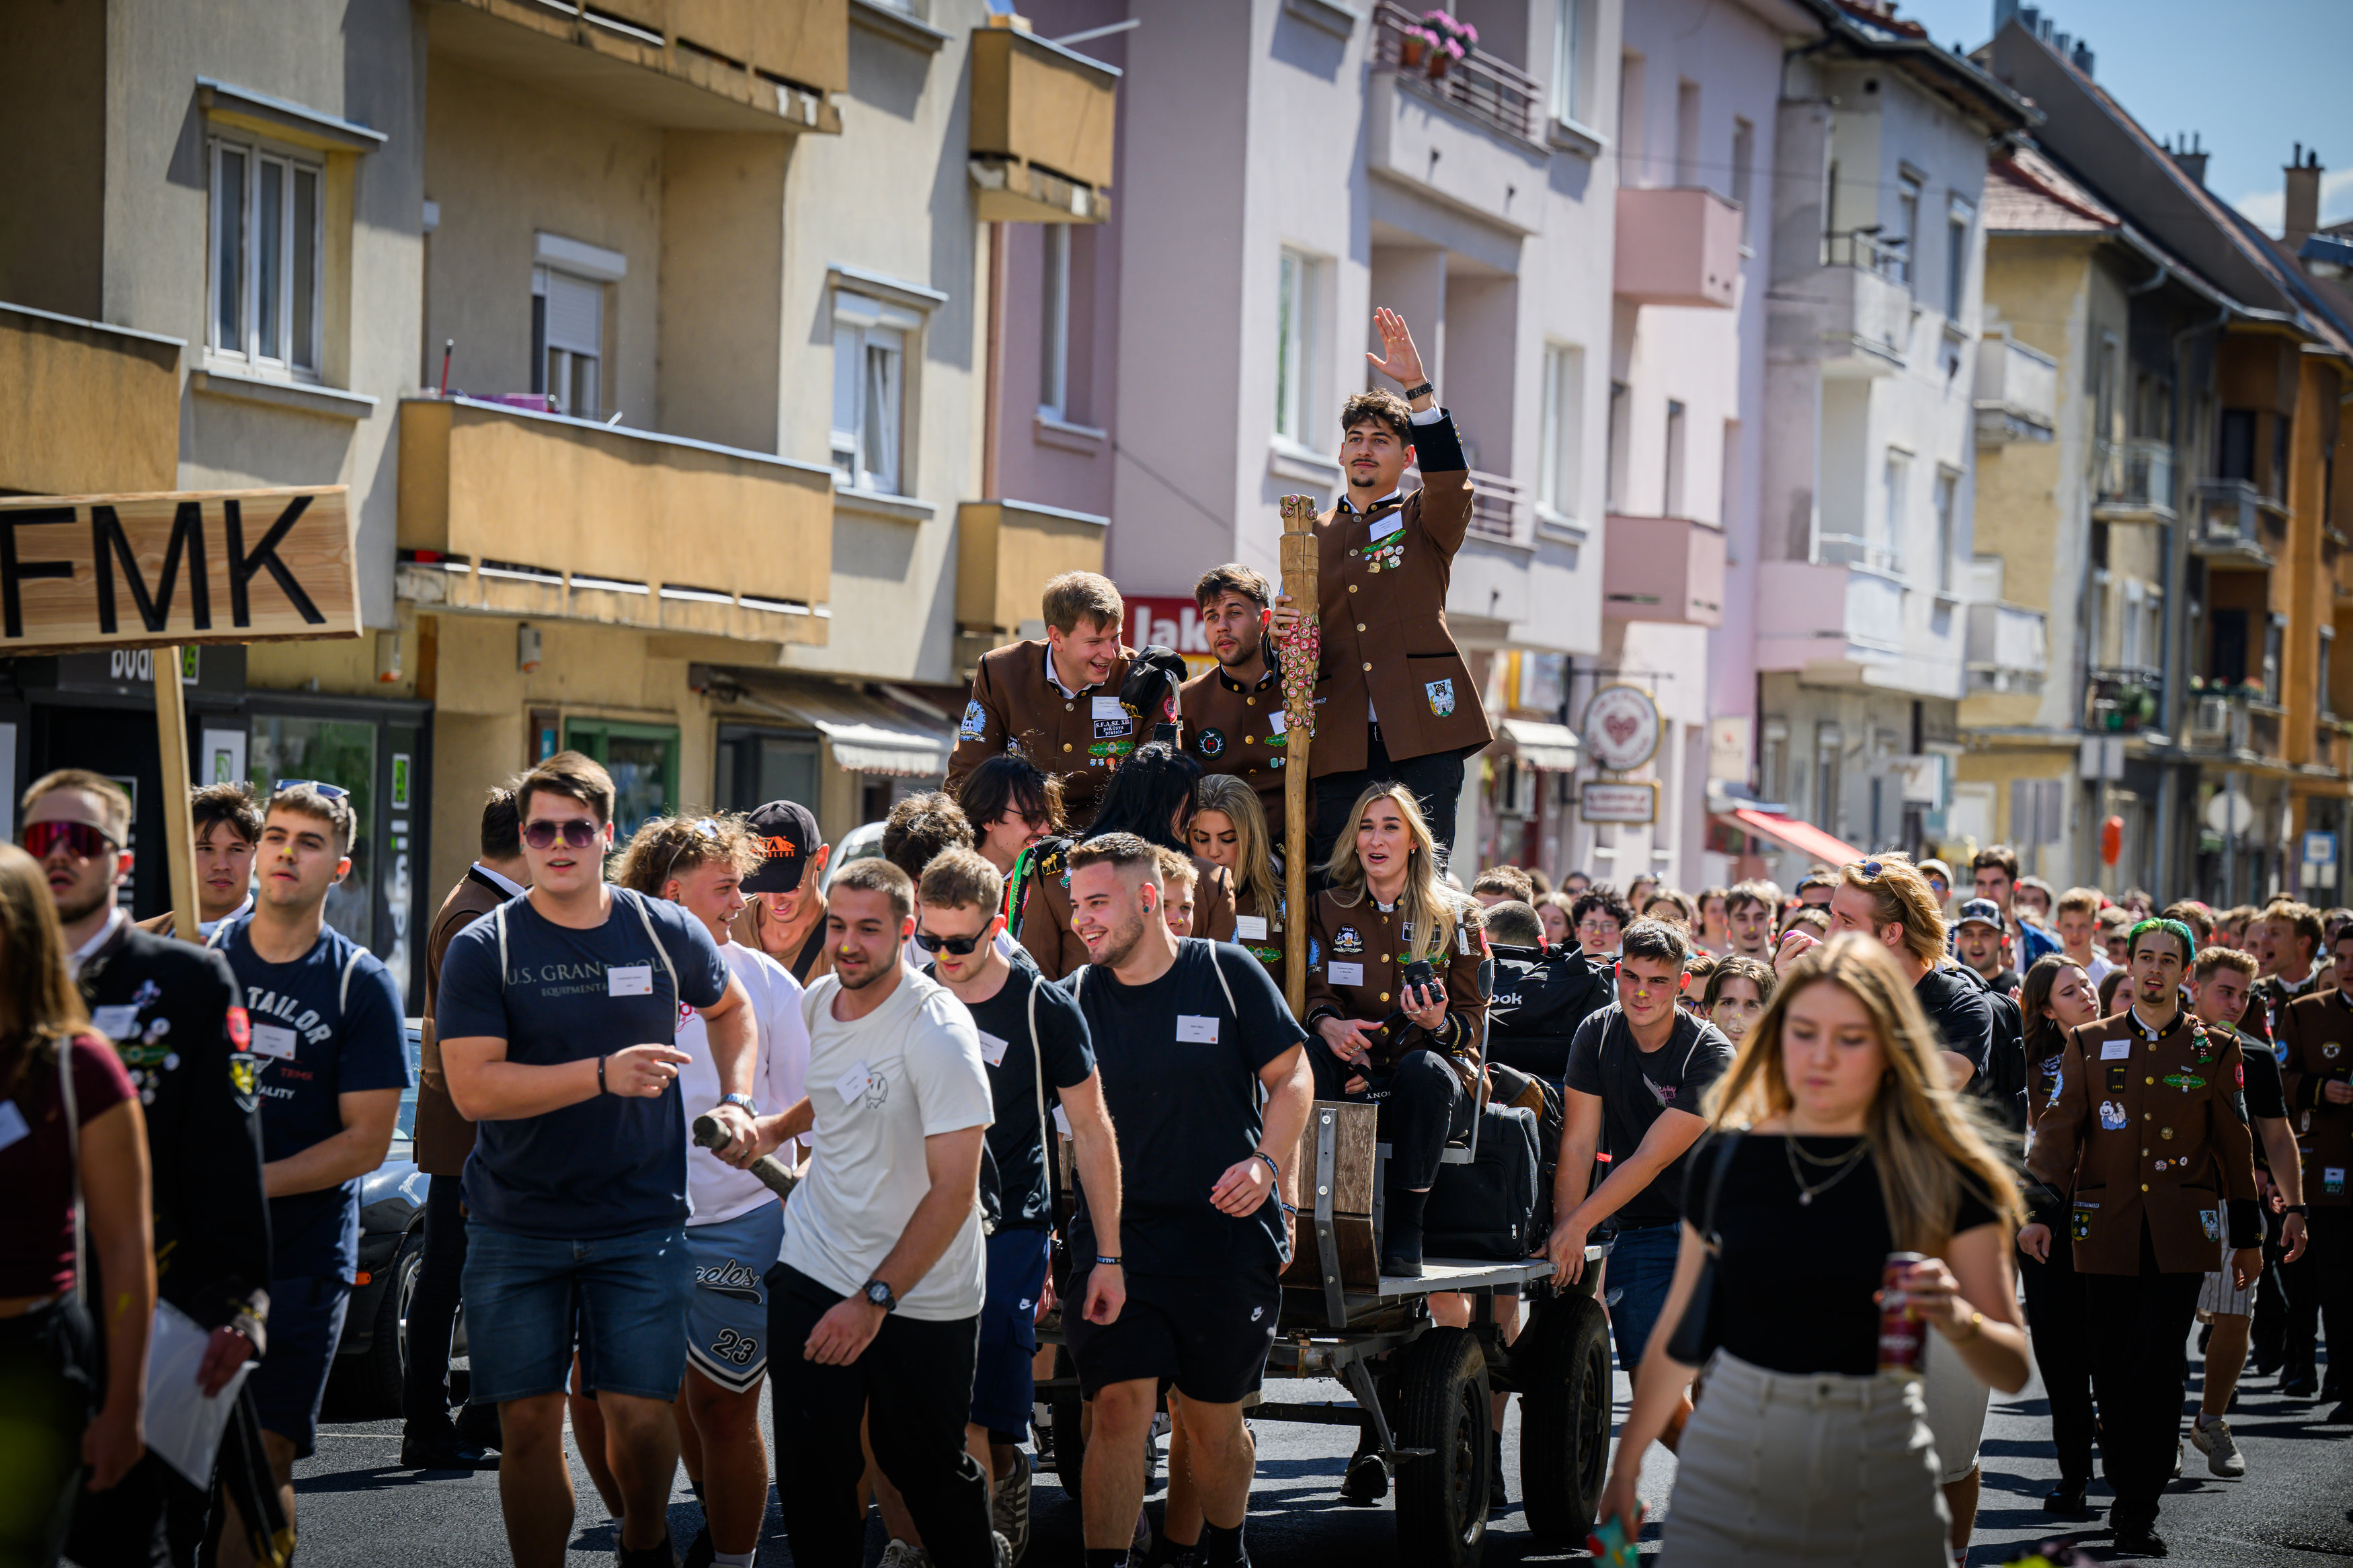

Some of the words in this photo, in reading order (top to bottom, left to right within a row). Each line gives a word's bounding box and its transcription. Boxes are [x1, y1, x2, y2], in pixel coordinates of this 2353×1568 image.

[0, 495, 326, 637] FMK
[1133, 606, 1210, 653] lak
[389, 820, 409, 975] udmil
[1008, 879, 1022, 913] Sopron
[541, 961, 614, 981] GRAN
[247, 986, 332, 1045] TAILOR
[259, 1085, 295, 1100] ALITY
[710, 1328, 758, 1365] 23
